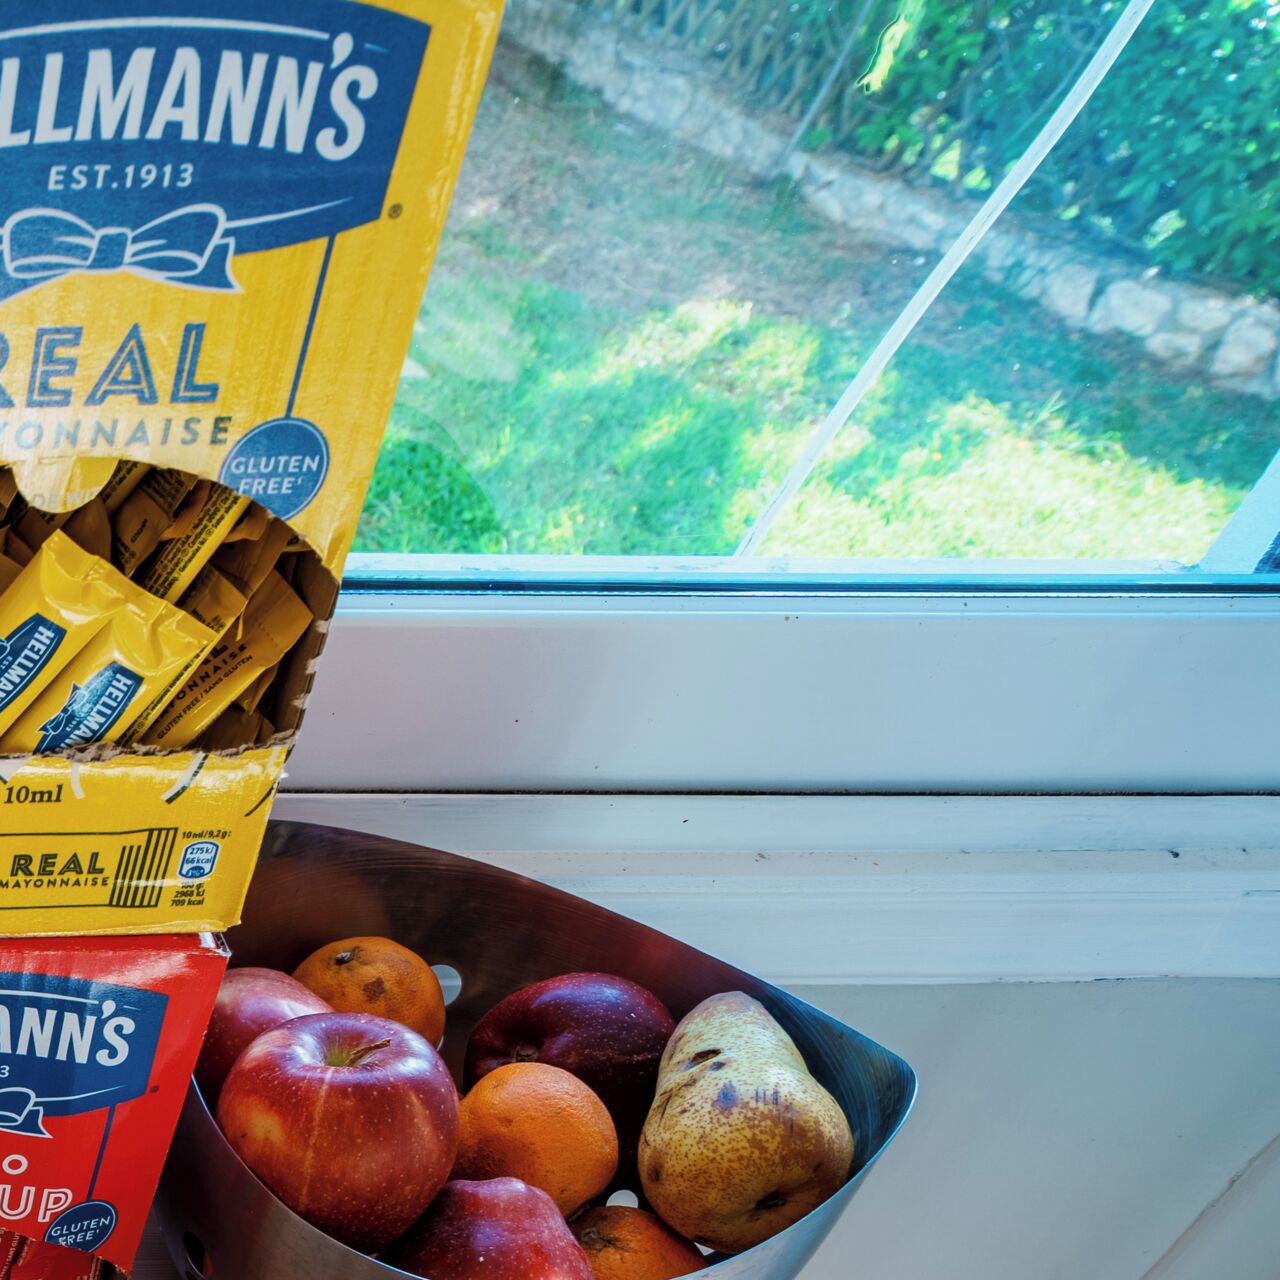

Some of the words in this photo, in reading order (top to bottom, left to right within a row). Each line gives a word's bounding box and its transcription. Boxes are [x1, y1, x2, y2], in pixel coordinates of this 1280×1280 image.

[47, 163, 194, 190] EST.1913
[230, 455, 319, 475] GLUTEN
[157, 714, 183, 740] GLUTEN
[4, 784, 63, 804] 10ml
[10, 851, 105, 876] REAL
[50, 1216, 112, 1238] GLUTEN
